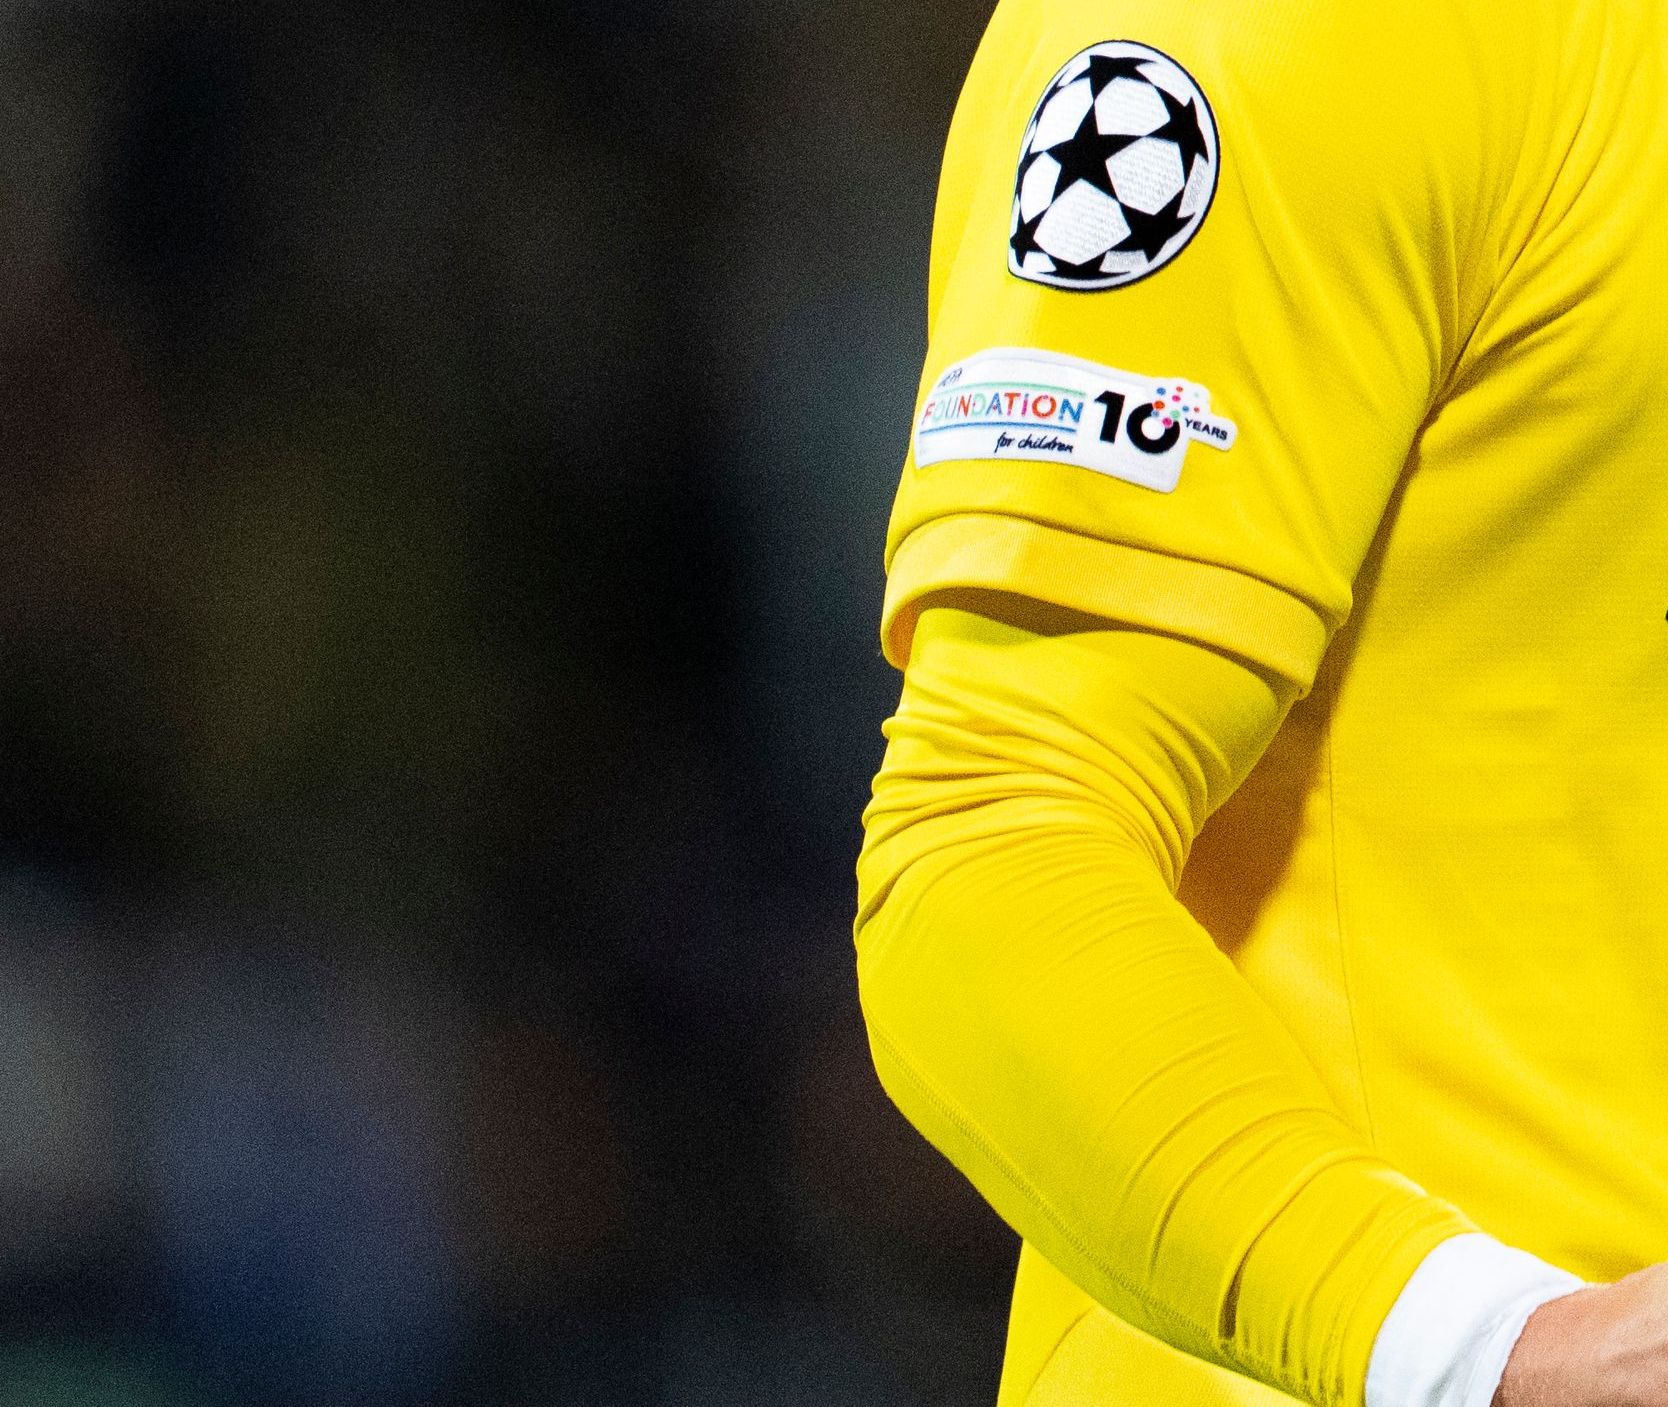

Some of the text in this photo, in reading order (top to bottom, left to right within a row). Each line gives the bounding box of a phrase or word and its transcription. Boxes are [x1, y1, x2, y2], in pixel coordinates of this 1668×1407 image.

[921, 392, 1084, 425] FOUNDATION
[1184, 417, 1228, 441] YEARS
[994, 431, 1074, 453] for children
